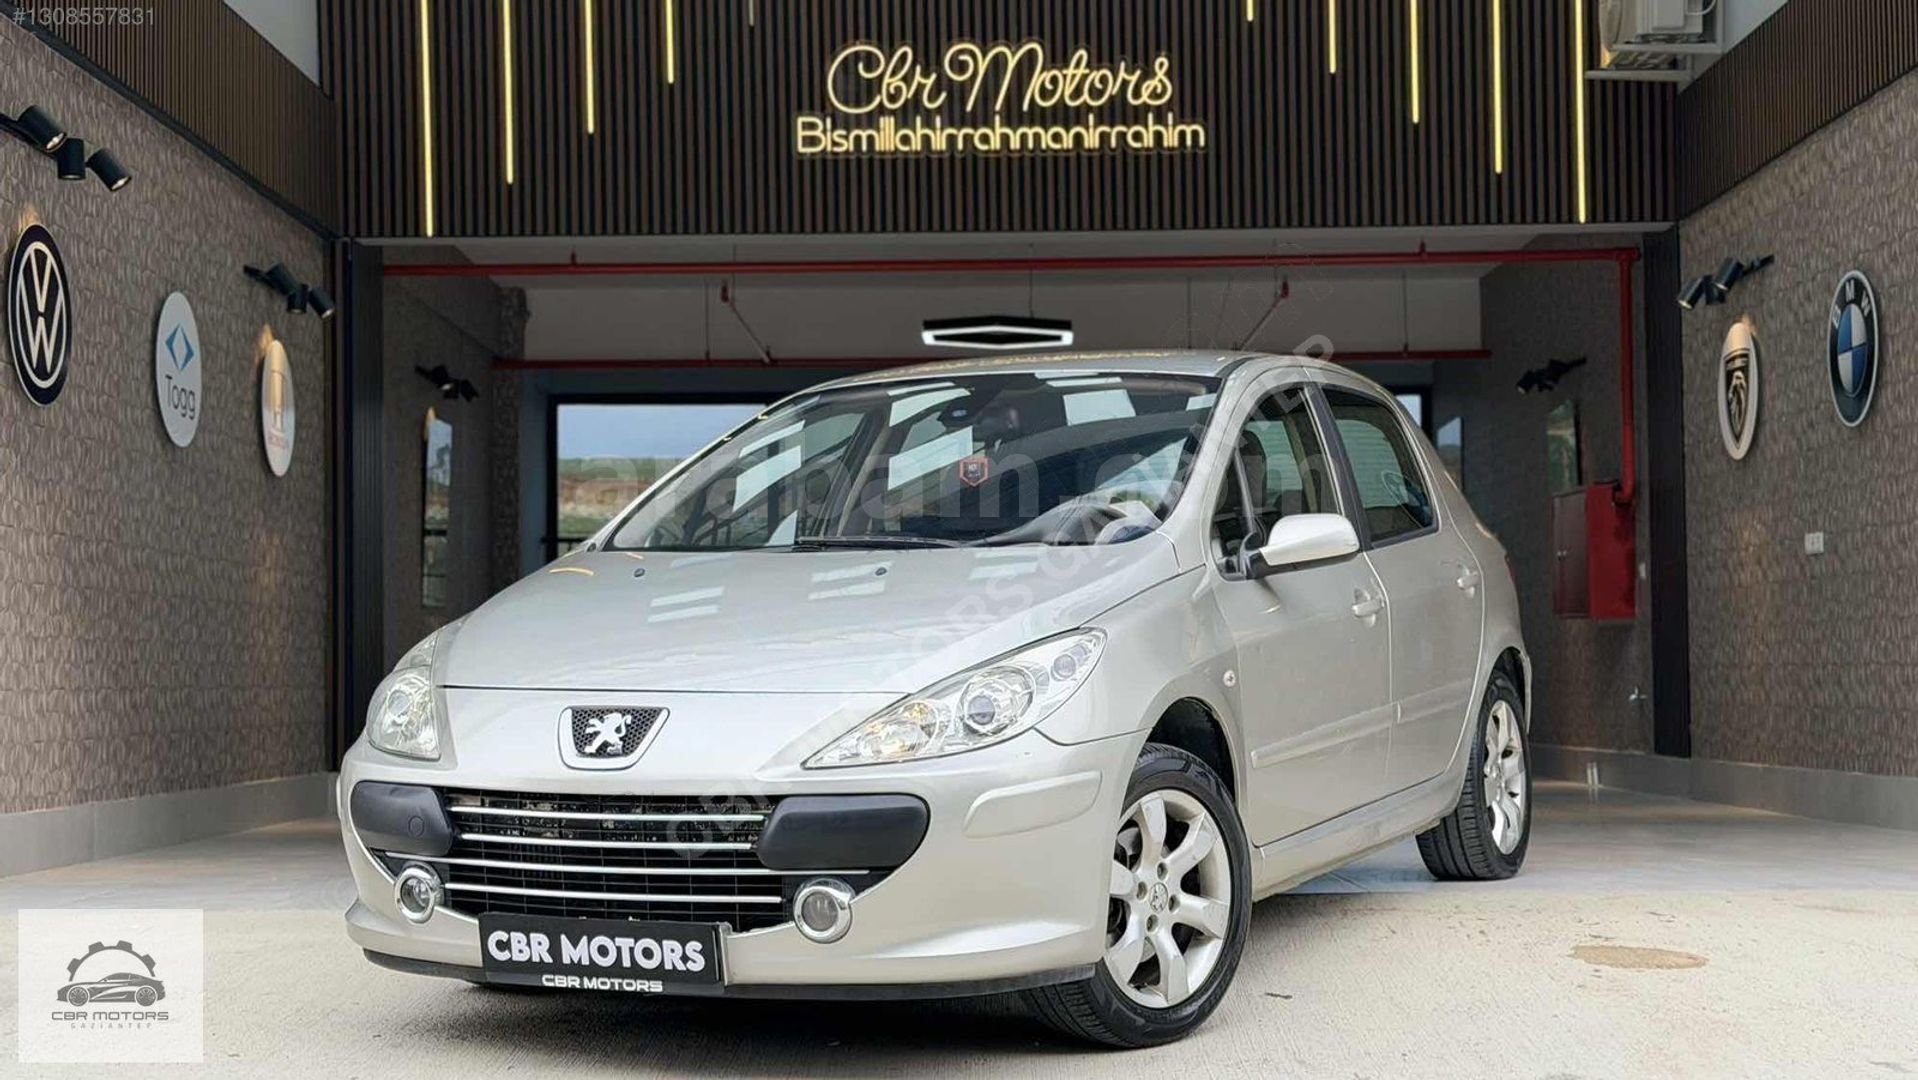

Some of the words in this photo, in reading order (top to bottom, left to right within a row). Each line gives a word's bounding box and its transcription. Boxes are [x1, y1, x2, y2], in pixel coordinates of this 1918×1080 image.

[827, 44, 946, 114] Cbr
[944, 42, 1173, 112] Motors
[796, 112, 1206, 153] Bismillahirrahmanirrahim
[165, 374, 196, 420] Togg
[487, 930, 552, 963] CBR
[560, 934, 705, 972] MOTORS
[541, 974, 580, 988] CBR
[583, 976, 663, 992] MOTORS
